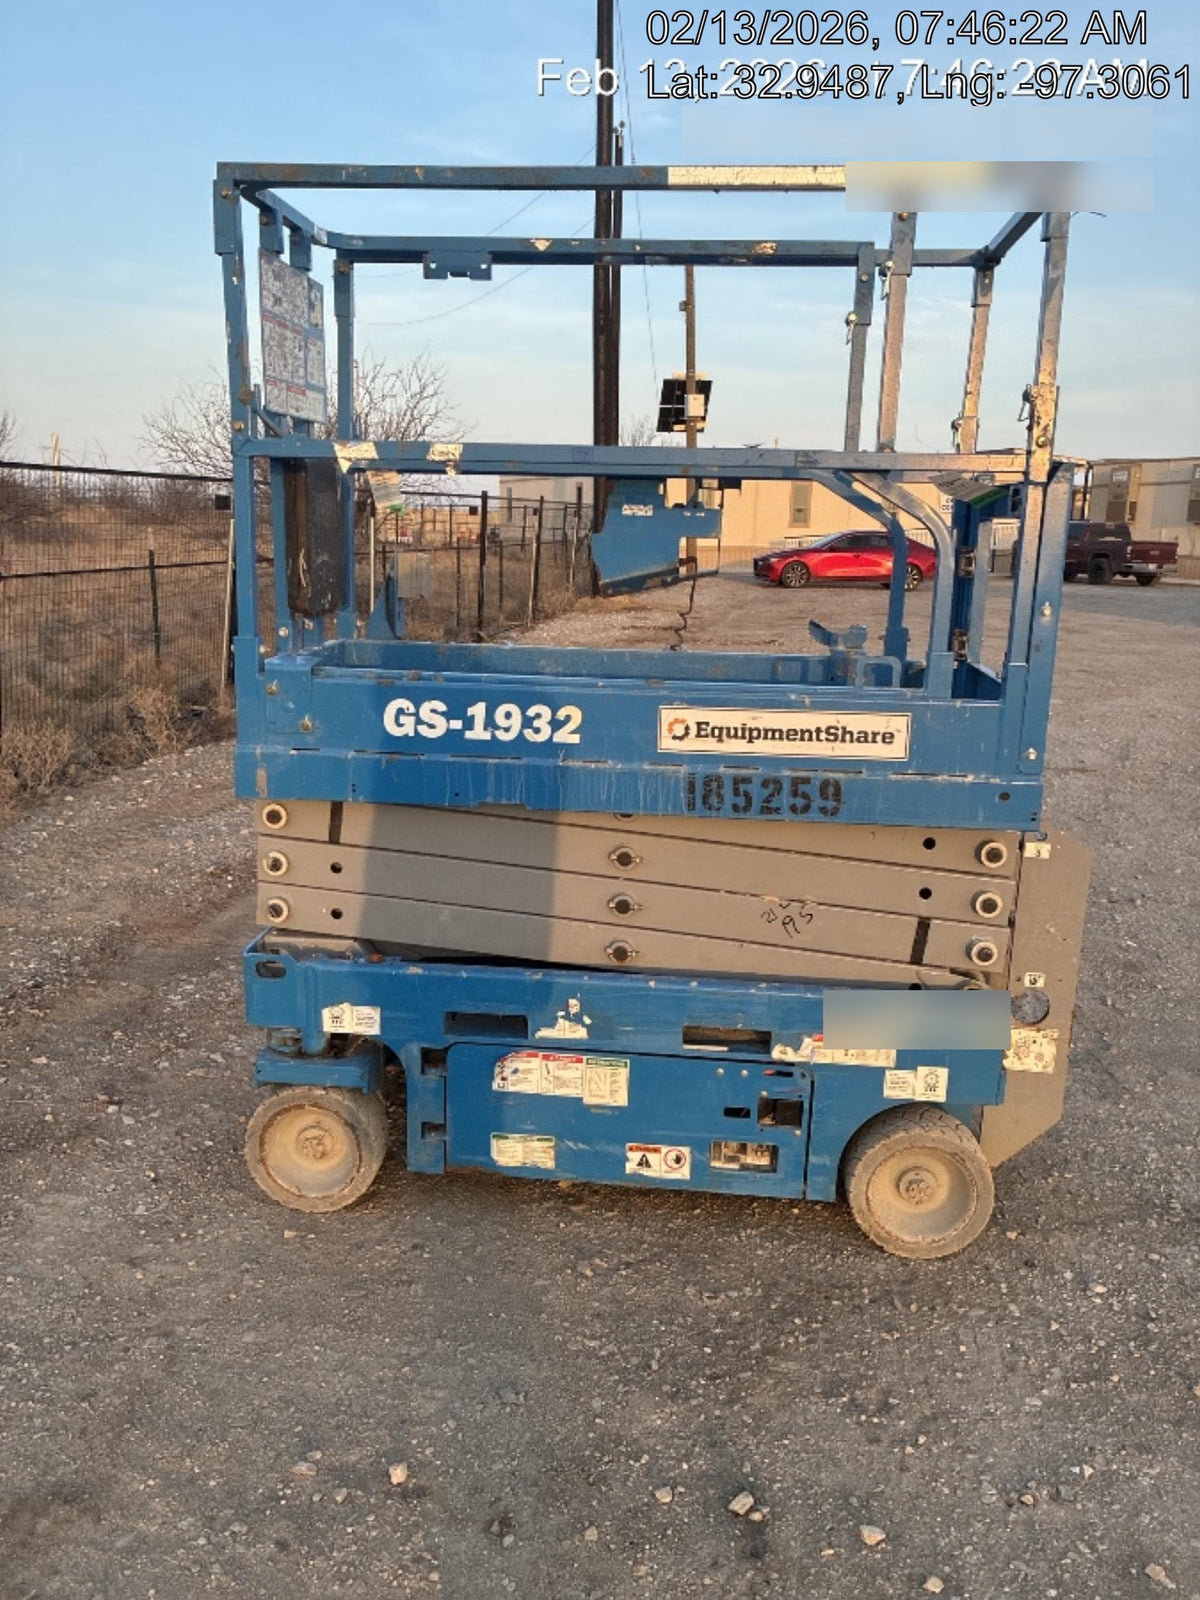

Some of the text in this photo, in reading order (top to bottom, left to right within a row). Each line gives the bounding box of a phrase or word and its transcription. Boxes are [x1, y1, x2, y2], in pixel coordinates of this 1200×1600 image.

[383, 698, 583, 745] GS-1932
[694, 721, 895, 744] EquipmentShare
[687, 773, 842, 817] 185259
